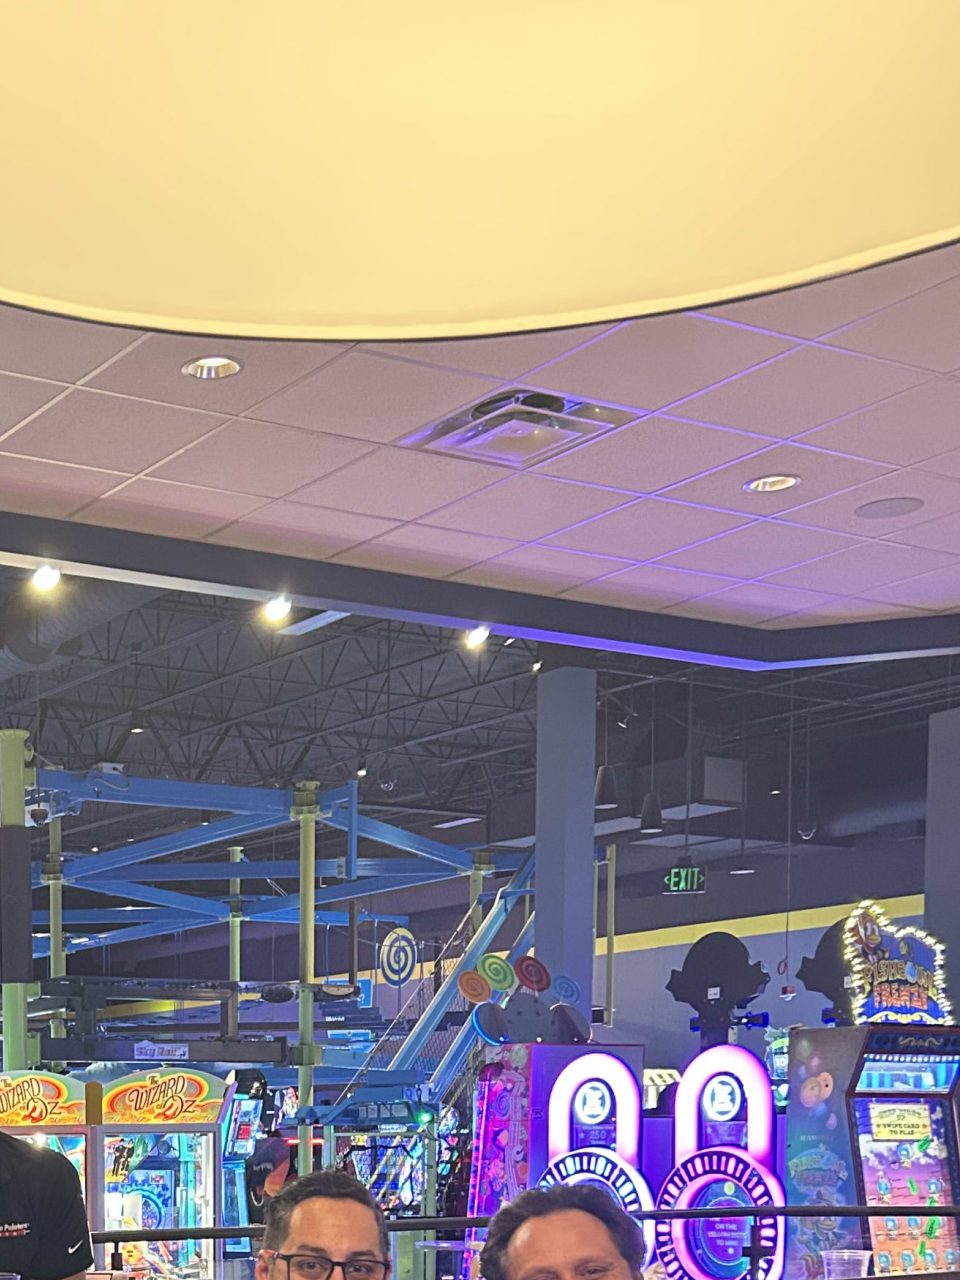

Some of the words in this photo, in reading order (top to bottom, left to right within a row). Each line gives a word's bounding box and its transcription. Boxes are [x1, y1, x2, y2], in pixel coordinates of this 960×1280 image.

[670, 867, 700, 890] EXIT
[1, 1079, 12, 1088] The
[148, 1075, 159, 1085] The
[128, 1075, 185, 1112] WIZARD
